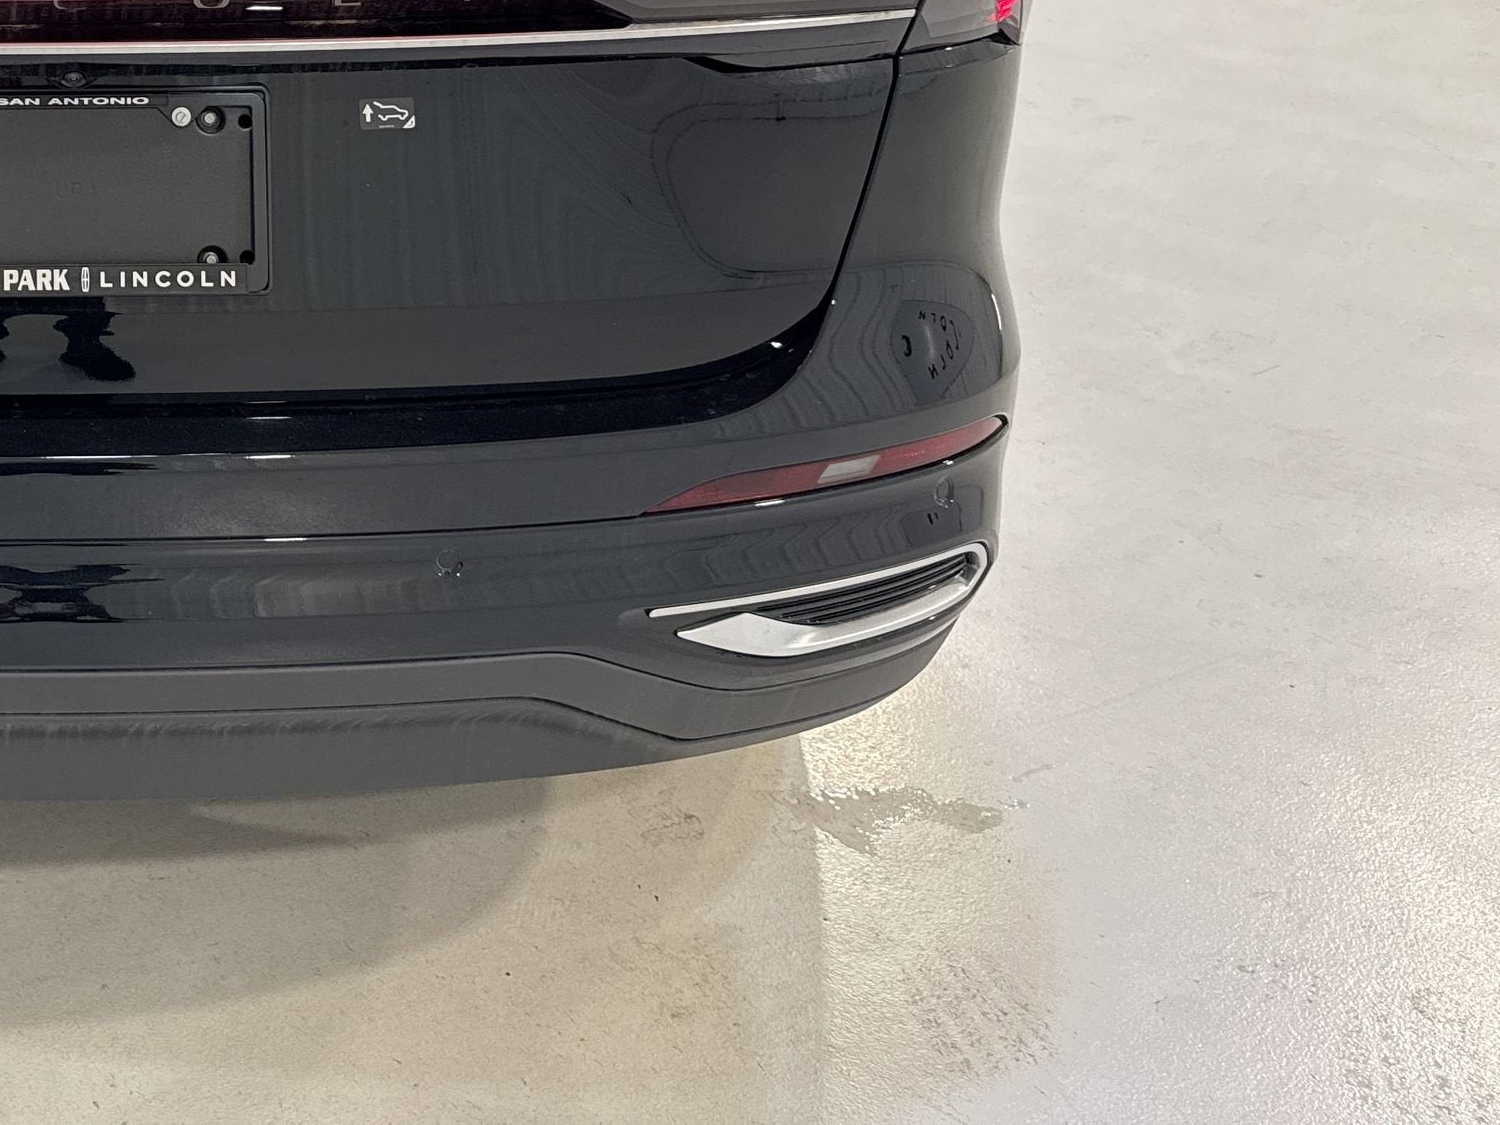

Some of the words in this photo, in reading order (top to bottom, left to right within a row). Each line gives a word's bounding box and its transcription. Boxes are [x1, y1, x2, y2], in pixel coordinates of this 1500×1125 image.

[48, 97, 149, 105] ANTONIO
[3, 269, 70, 291] PARK
[100, 270, 236, 288] LINCOLN
